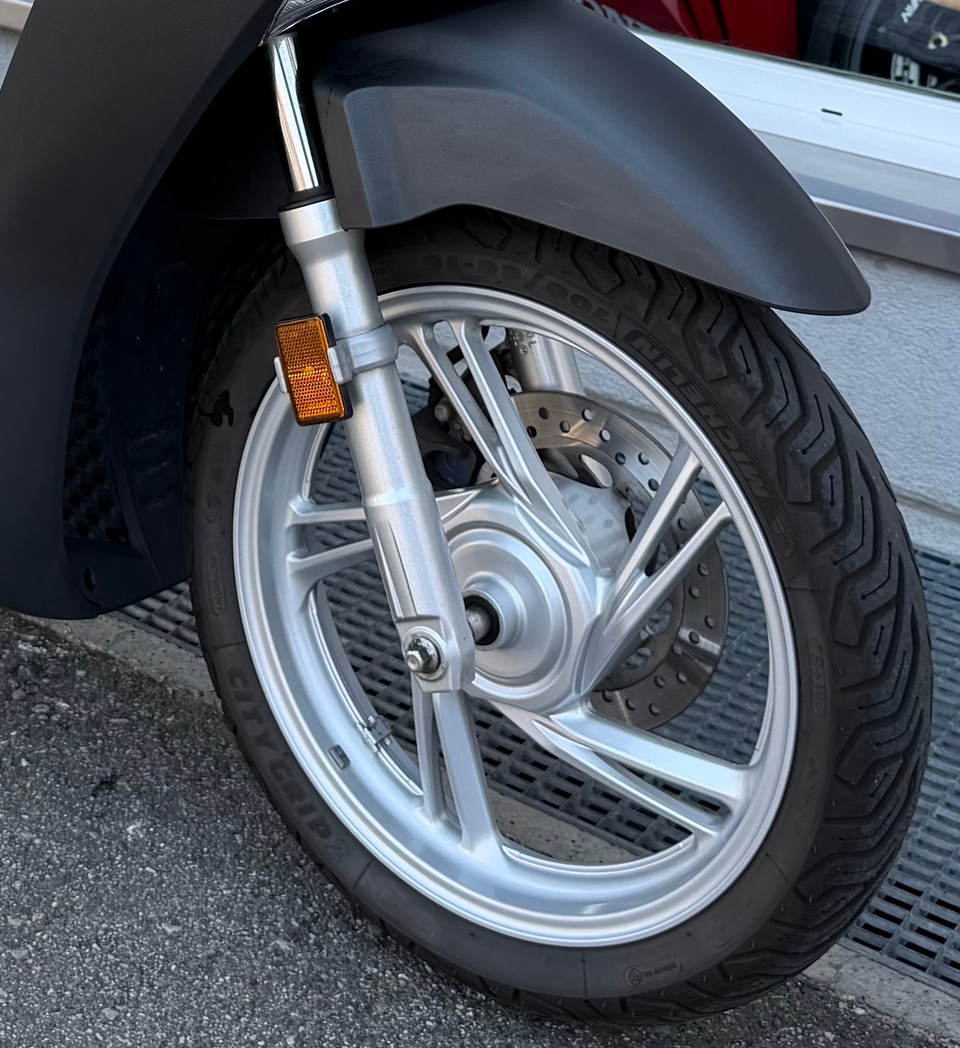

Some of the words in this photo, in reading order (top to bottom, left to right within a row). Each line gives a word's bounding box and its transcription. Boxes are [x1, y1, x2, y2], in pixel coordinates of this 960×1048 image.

[634, 335, 774, 500] MICHELIN
[229, 667, 275, 753] CITY
[271, 758, 332, 842] GRIP
